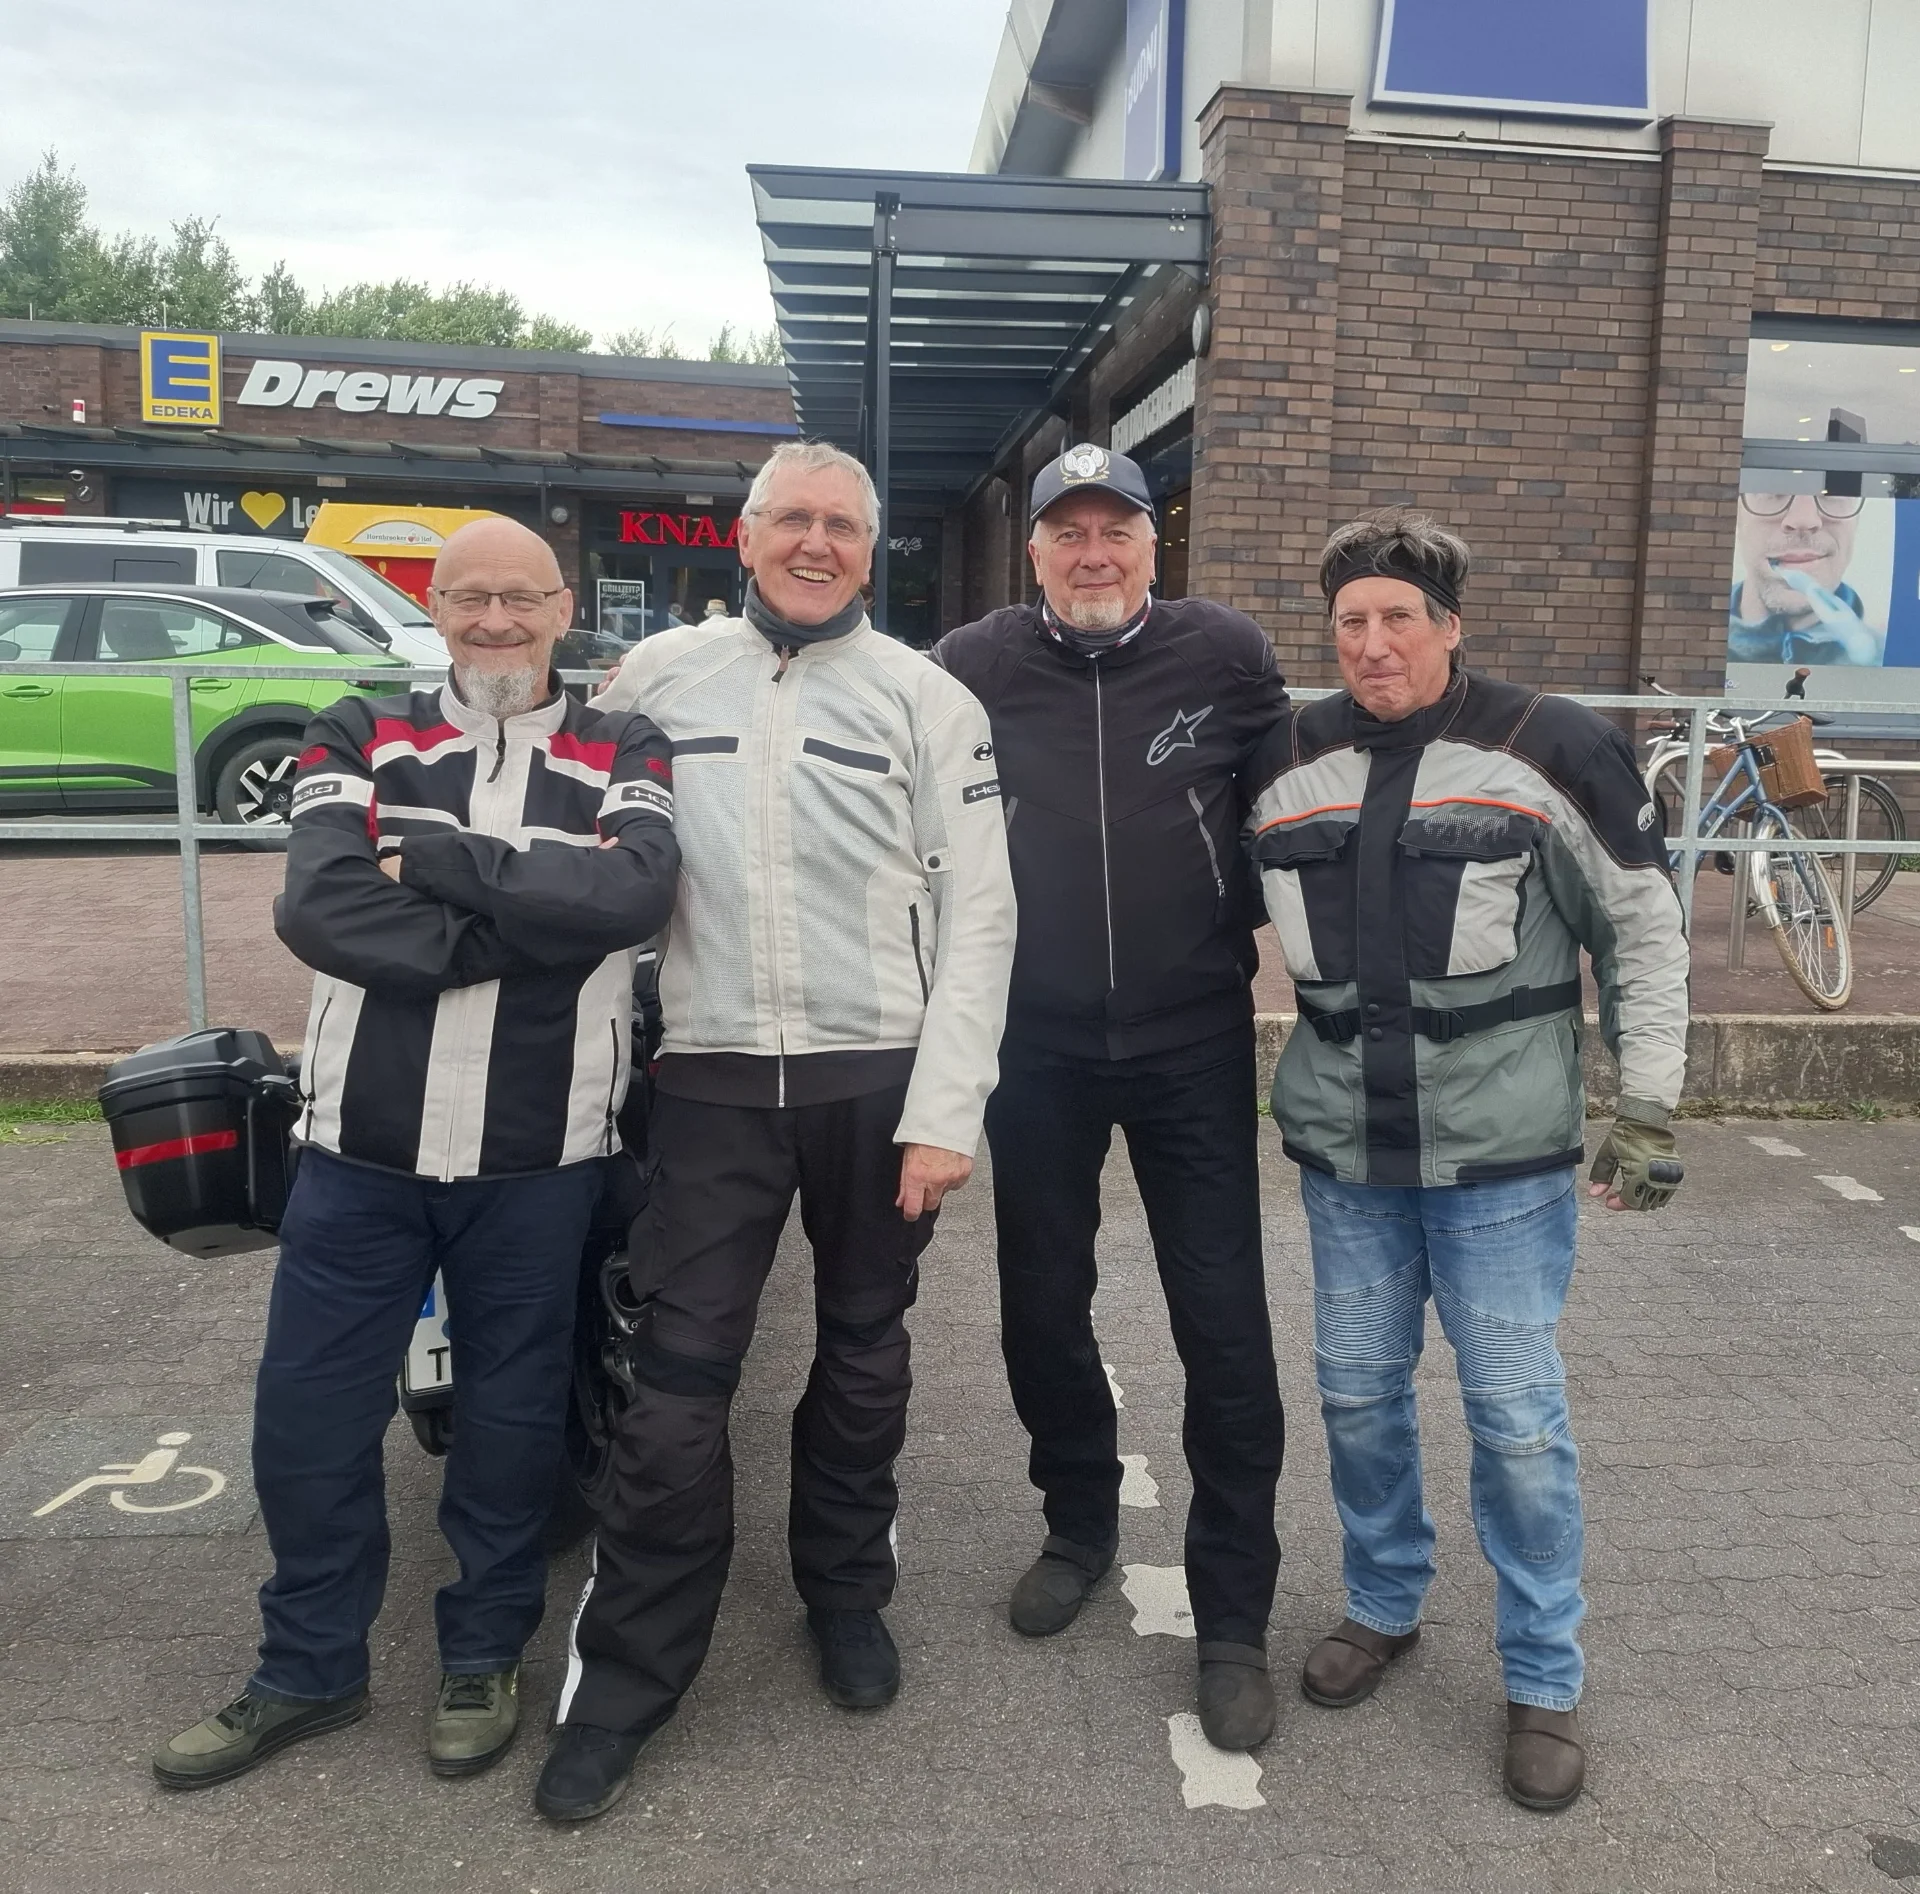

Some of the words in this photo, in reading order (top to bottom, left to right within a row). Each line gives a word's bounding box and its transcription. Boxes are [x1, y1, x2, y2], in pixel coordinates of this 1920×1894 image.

[237, 360, 505, 418] Drews
[151, 404, 214, 420] EDEKA
[184, 492, 235, 525] Wir
